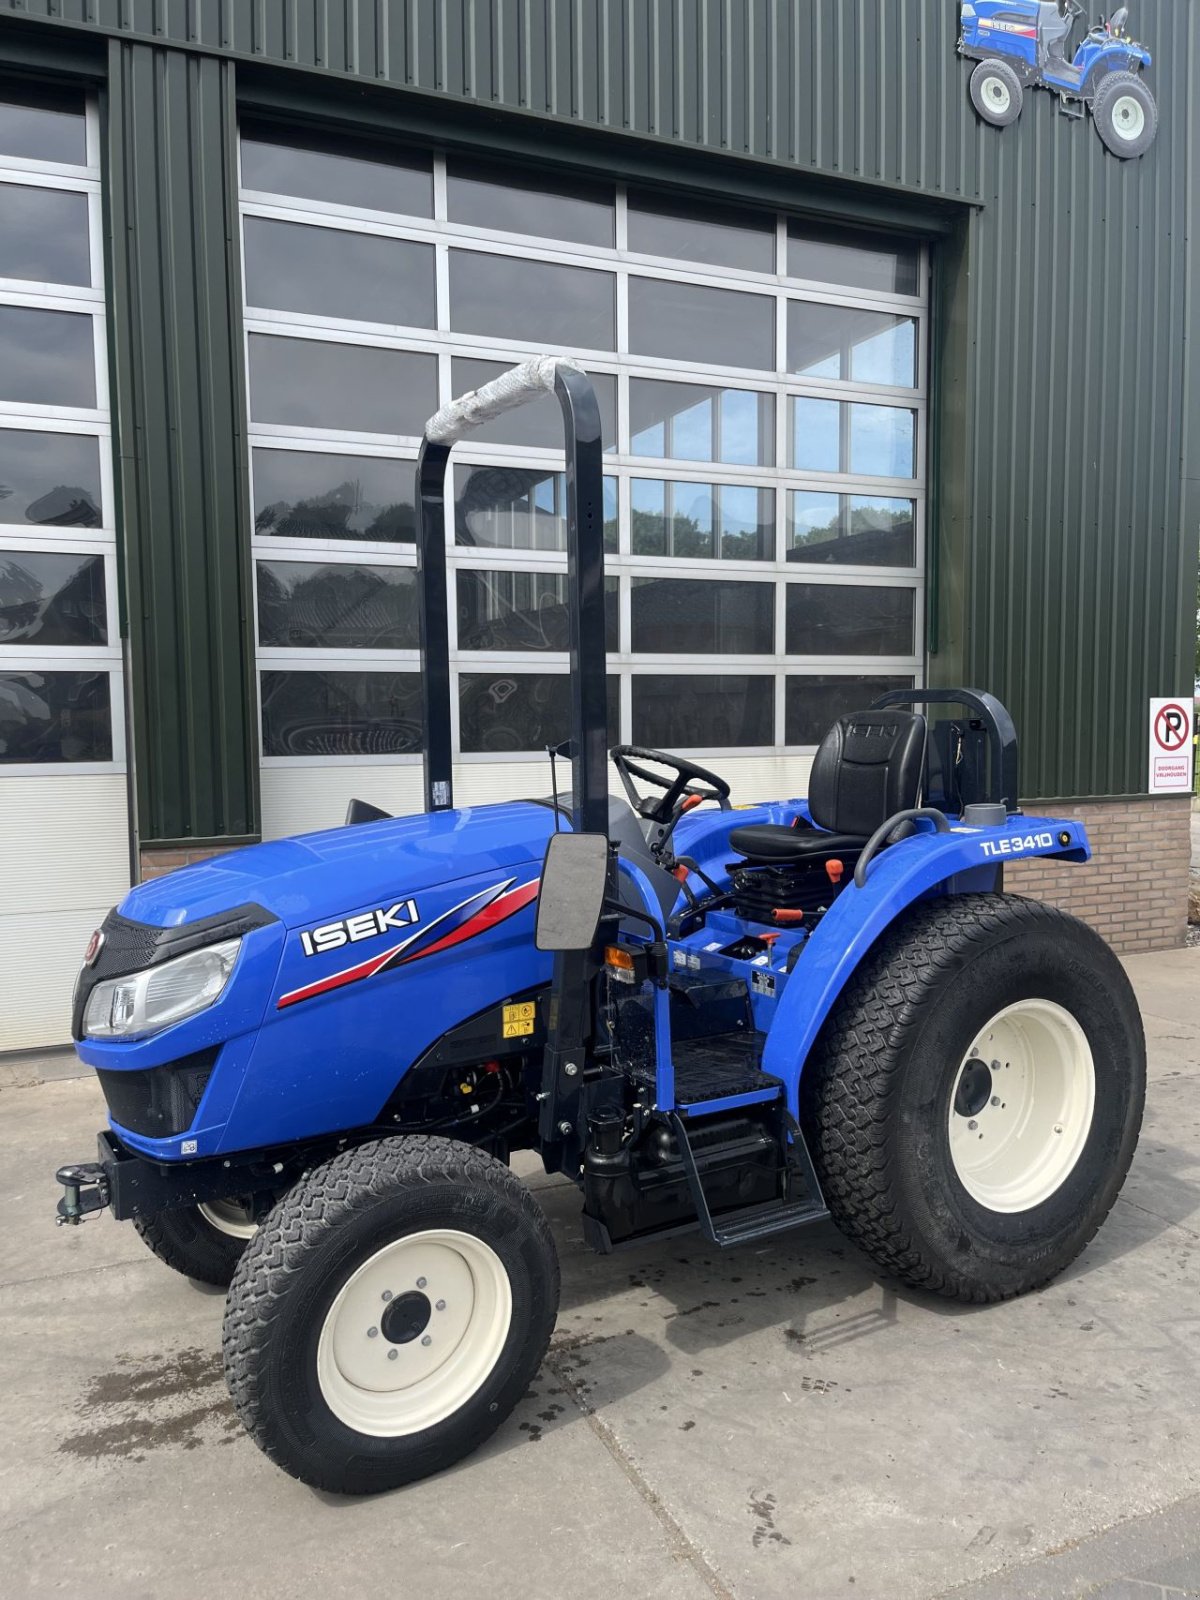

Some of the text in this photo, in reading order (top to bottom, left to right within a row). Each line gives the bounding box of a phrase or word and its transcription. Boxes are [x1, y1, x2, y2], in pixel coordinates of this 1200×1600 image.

[1165, 712, 1182, 743] P
[980, 833, 1053, 856] TLE3410
[301, 898, 420, 957] ISEKI
